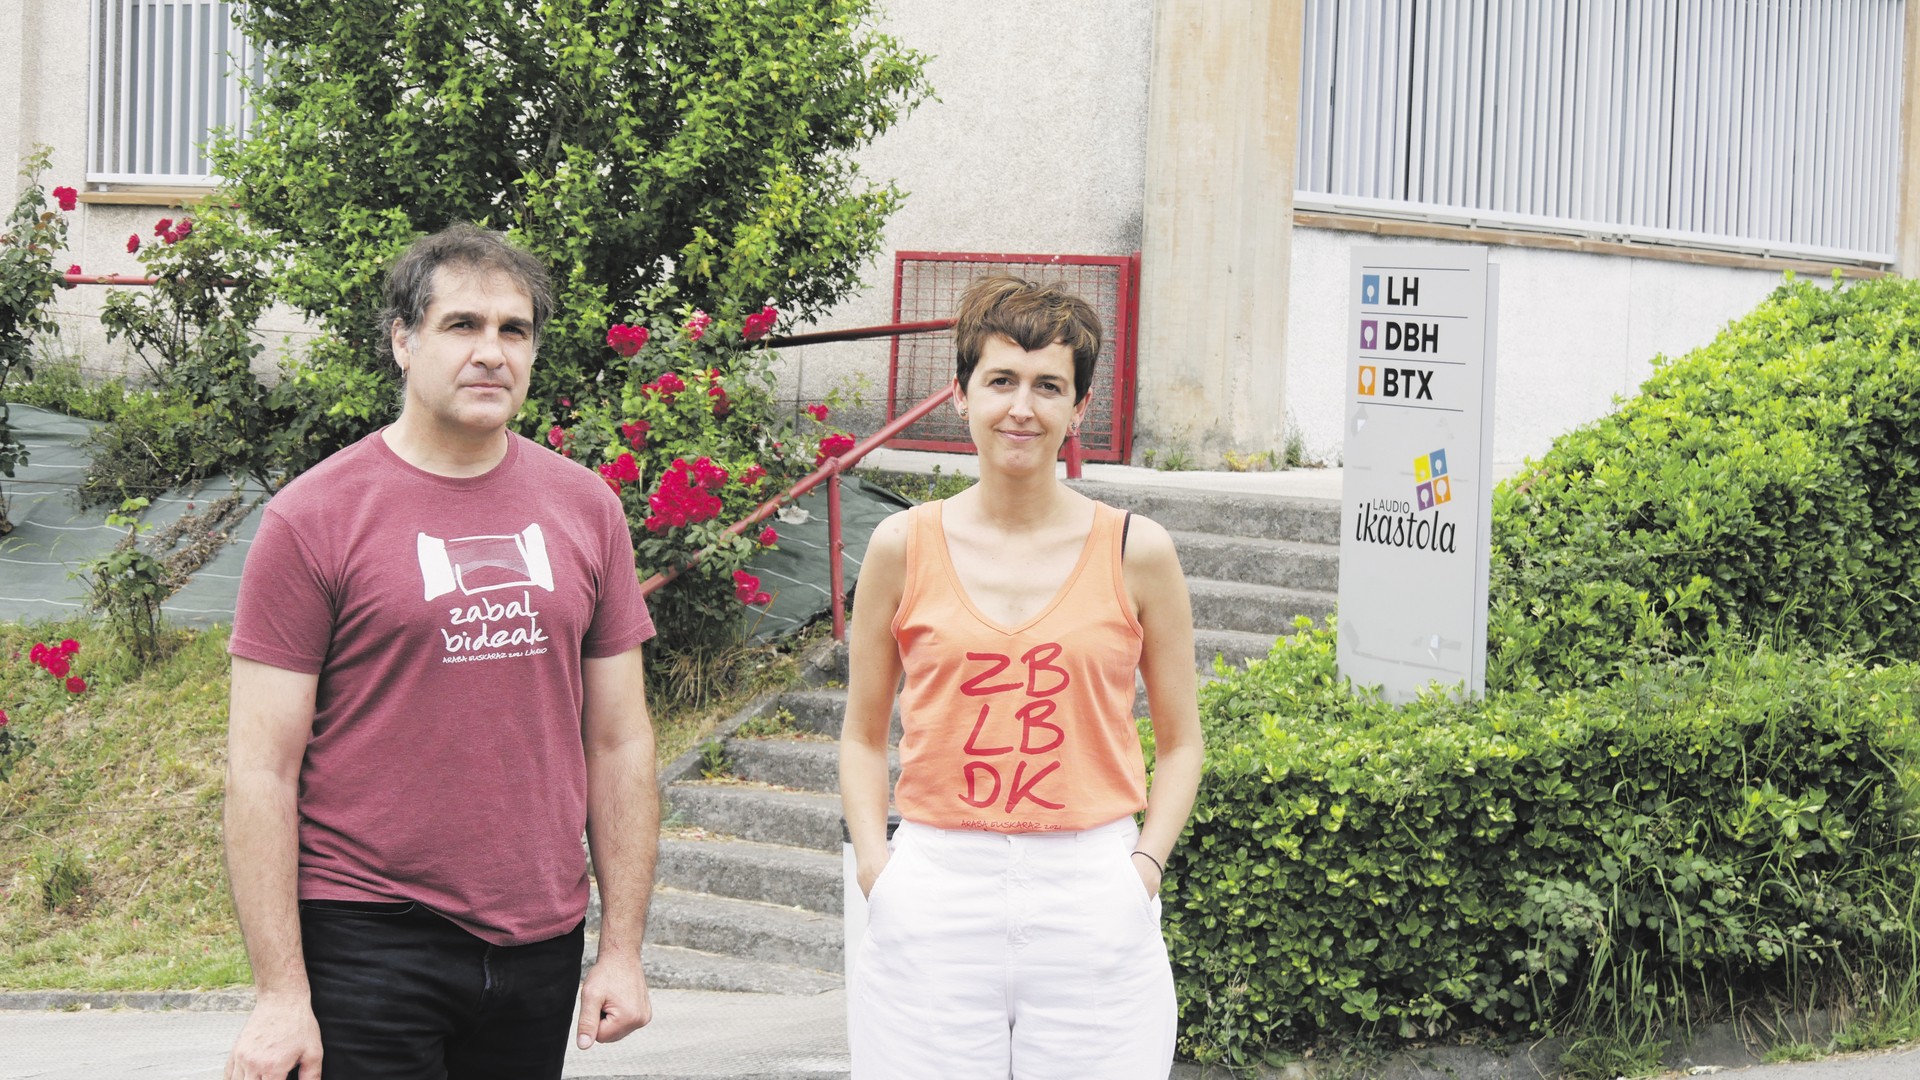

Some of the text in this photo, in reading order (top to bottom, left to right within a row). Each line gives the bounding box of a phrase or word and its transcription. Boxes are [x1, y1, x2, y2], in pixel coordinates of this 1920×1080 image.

[1387, 276, 1419, 306] LH
[1385, 321, 1439, 353] DBH
[1383, 367, 1434, 400] BTX
[1373, 498, 1410, 514] LAUDIO
[1356, 502, 1456, 554] ikastola
[449, 590, 539, 625] zabal
[440, 617, 549, 652] bideak
[442, 655, 467, 664] ARABA
[960, 642, 1070, 698] ZB
[963, 699, 1065, 756] LB
[958, 760, 1066, 814] DK
[961, 820, 987, 829] ARABA
[990, 821, 1042, 830] EUSKARAZ
